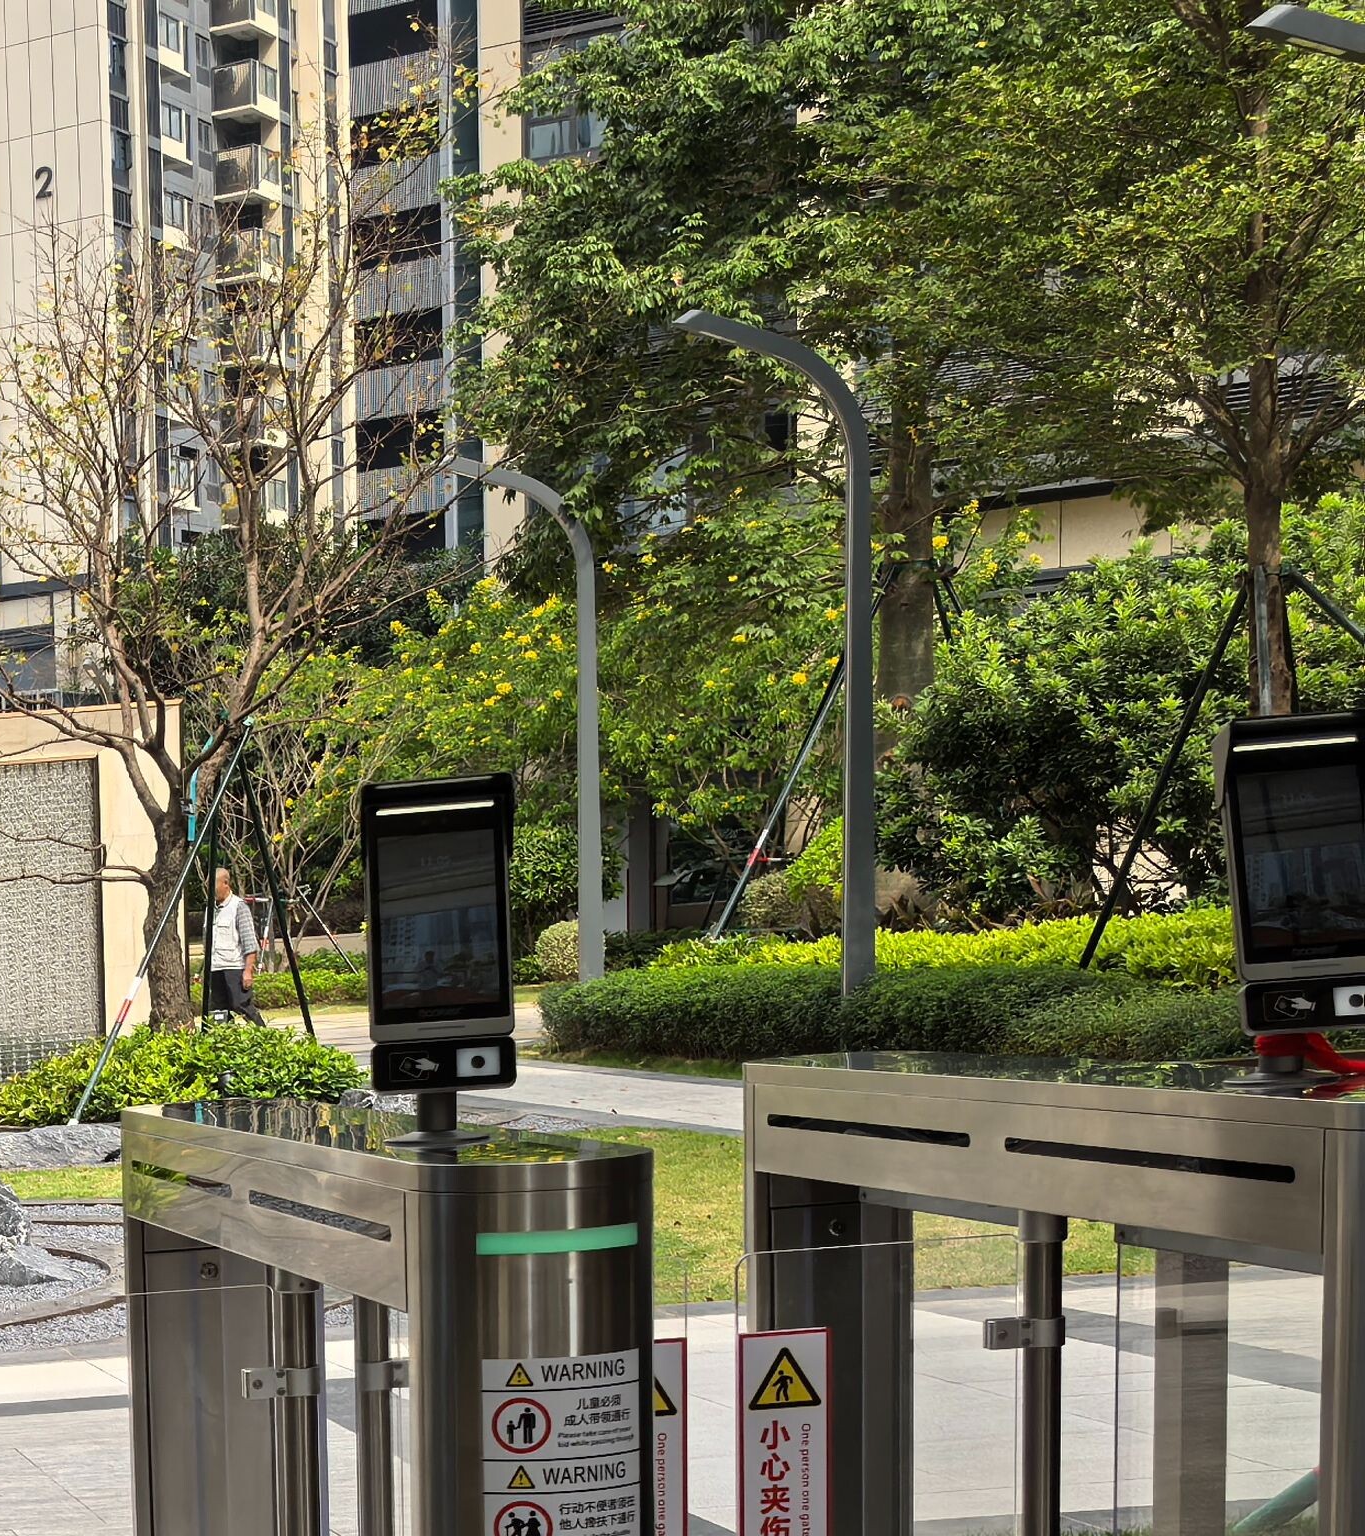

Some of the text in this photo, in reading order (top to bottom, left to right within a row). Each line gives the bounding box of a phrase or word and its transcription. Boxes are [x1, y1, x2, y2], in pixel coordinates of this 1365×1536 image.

[35, 166, 53, 199] 2
[541, 1359, 625, 1382] WARNING
[542, 1461, 626, 1485] WARNING
